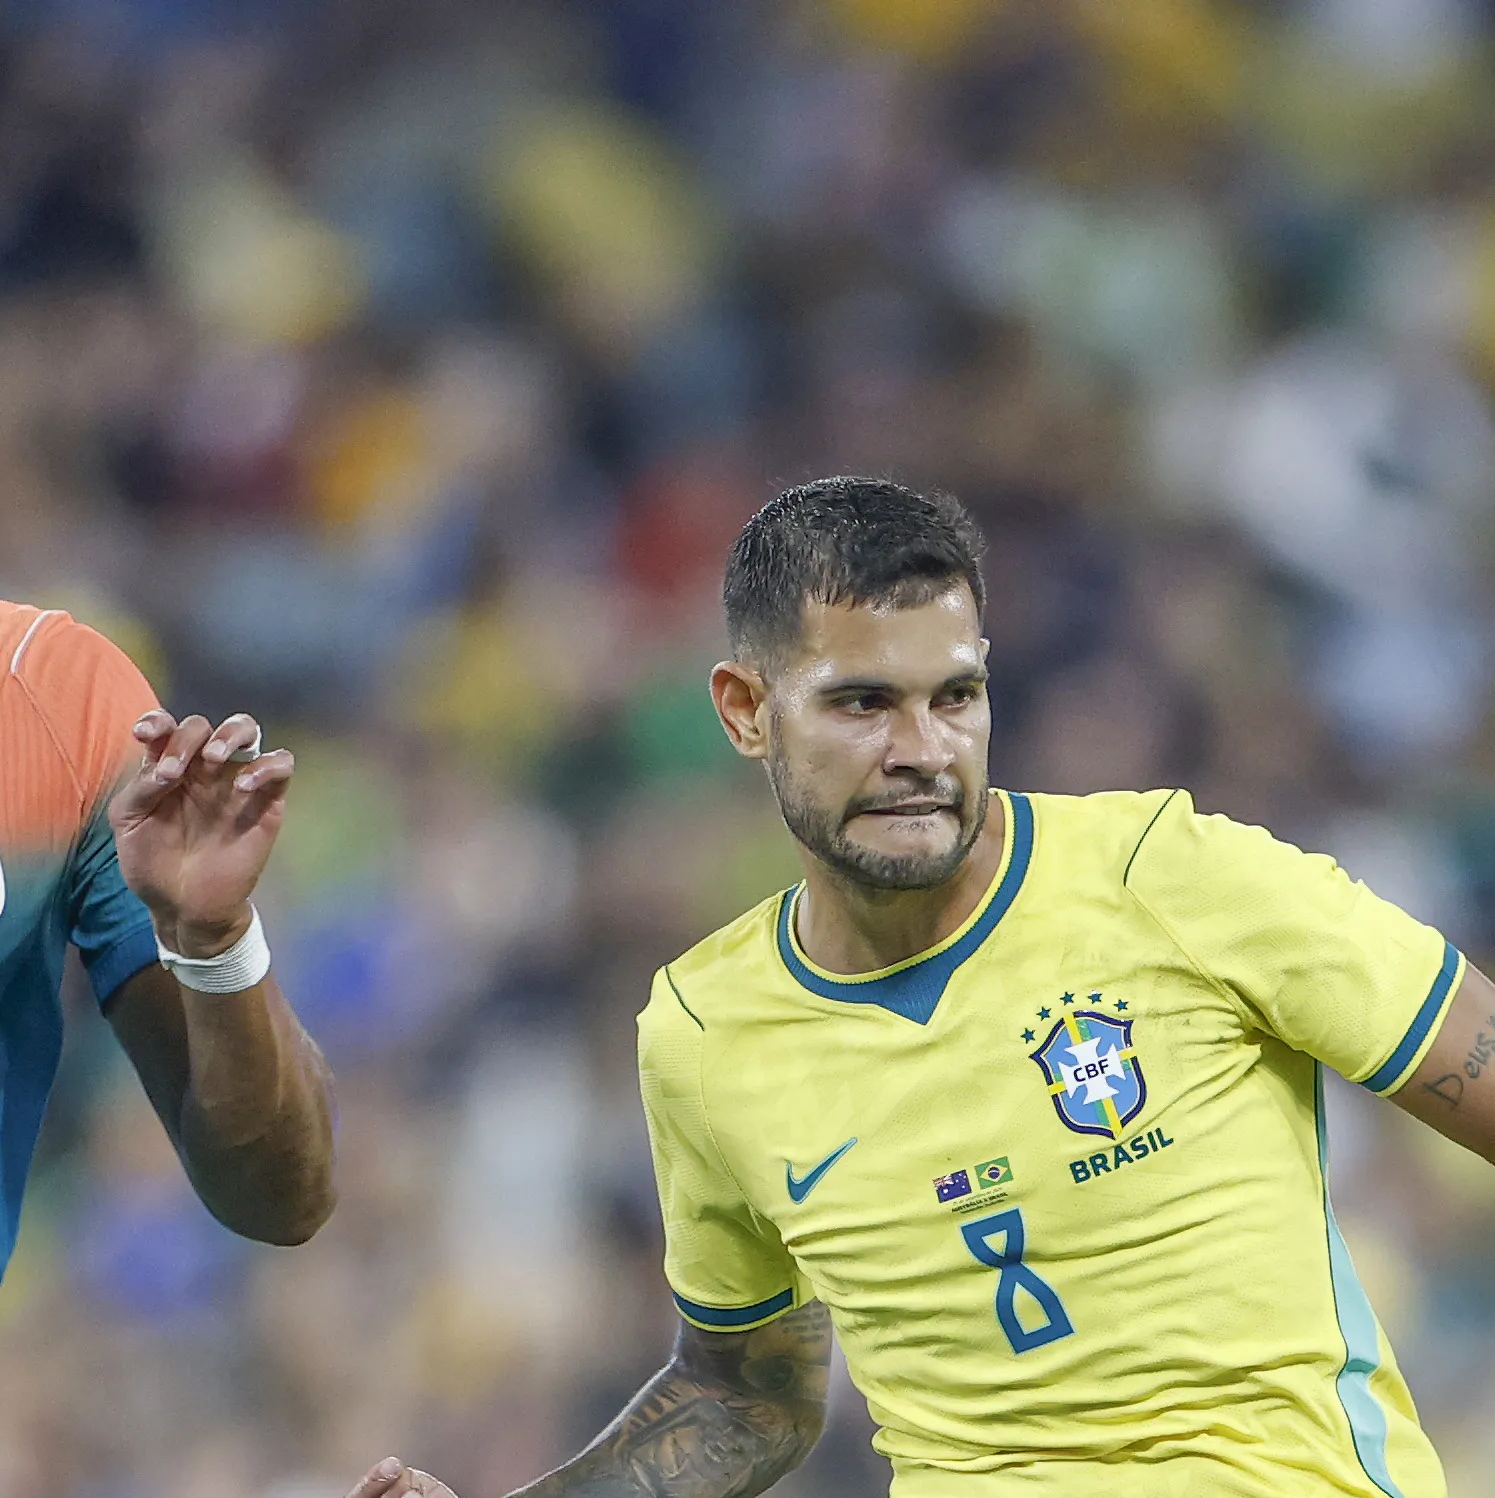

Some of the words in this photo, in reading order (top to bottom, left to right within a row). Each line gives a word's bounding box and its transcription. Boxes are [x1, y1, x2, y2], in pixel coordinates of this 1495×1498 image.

[1073, 1058, 1110, 1083] CBF
[1069, 1127, 1174, 1184] BRASIL
[960, 1207, 1075, 1354] 8
